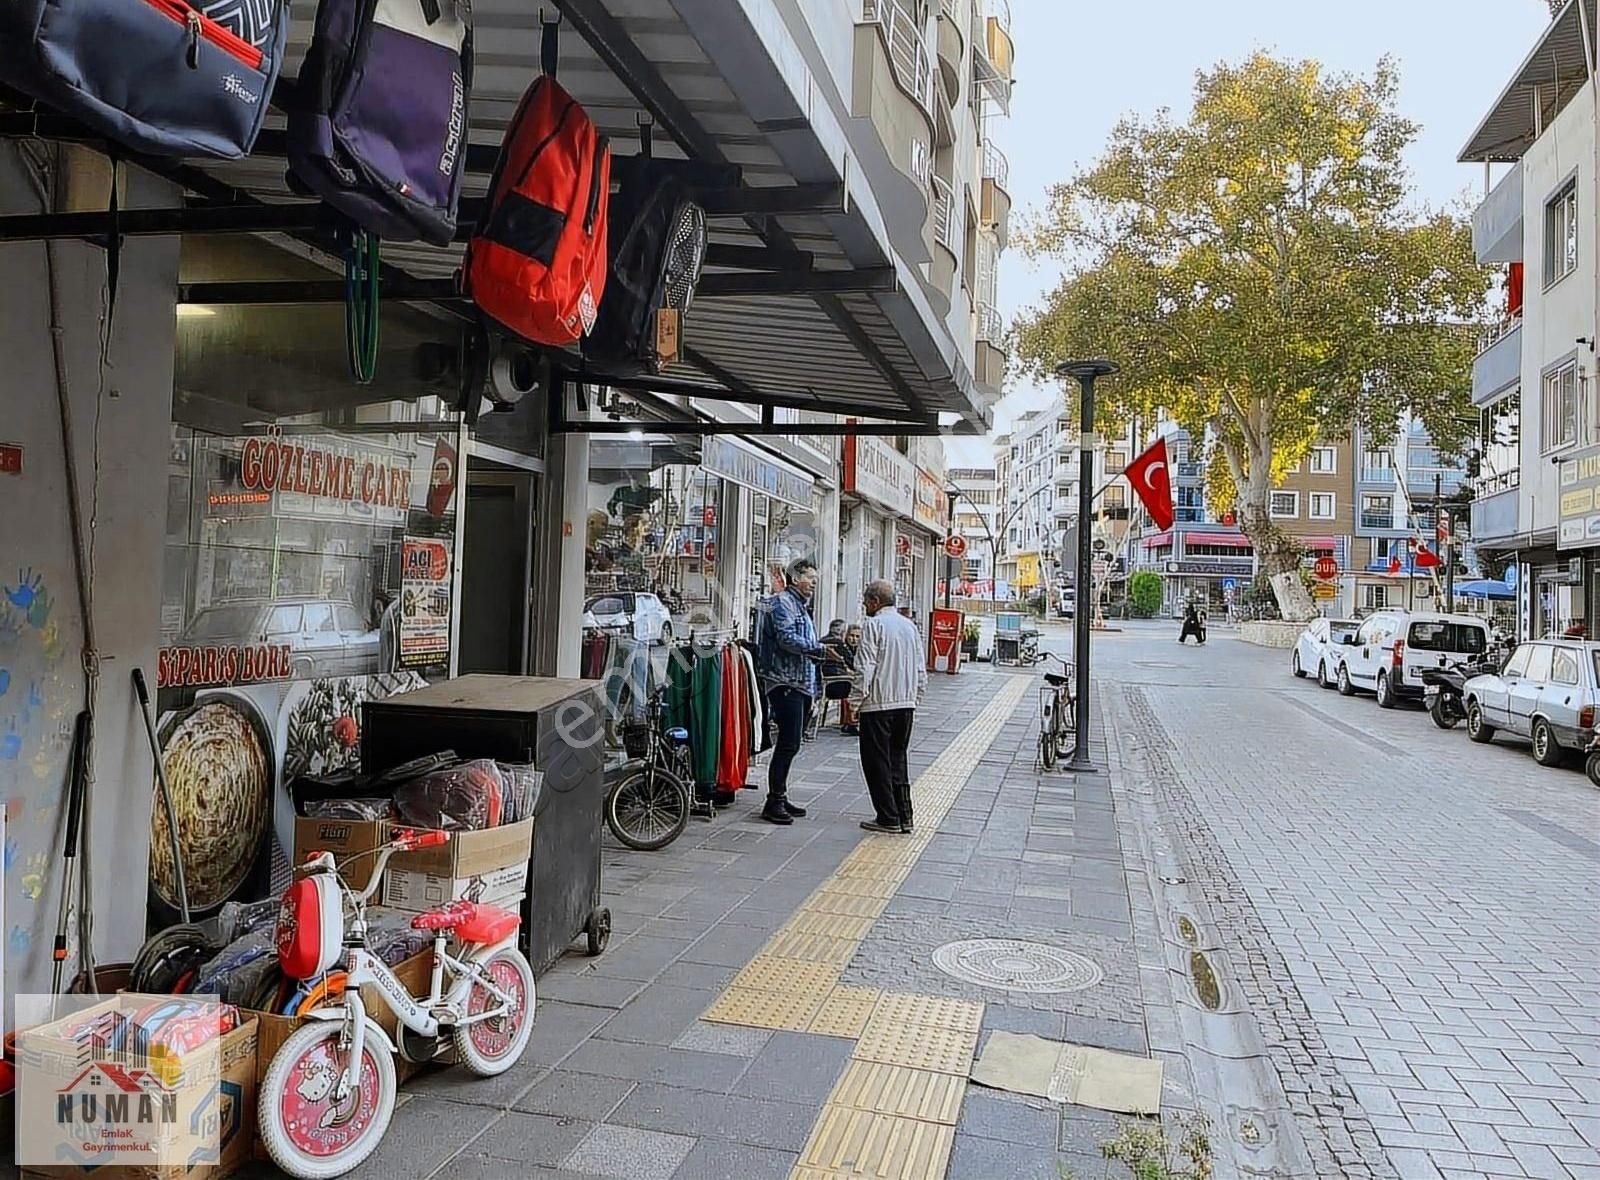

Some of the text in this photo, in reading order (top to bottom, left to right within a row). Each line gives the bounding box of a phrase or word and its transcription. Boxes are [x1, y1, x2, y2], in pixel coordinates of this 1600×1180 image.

[241, 424, 412, 510] GÖZLEME CAFE
[1315, 563, 1336, 574] DUR
